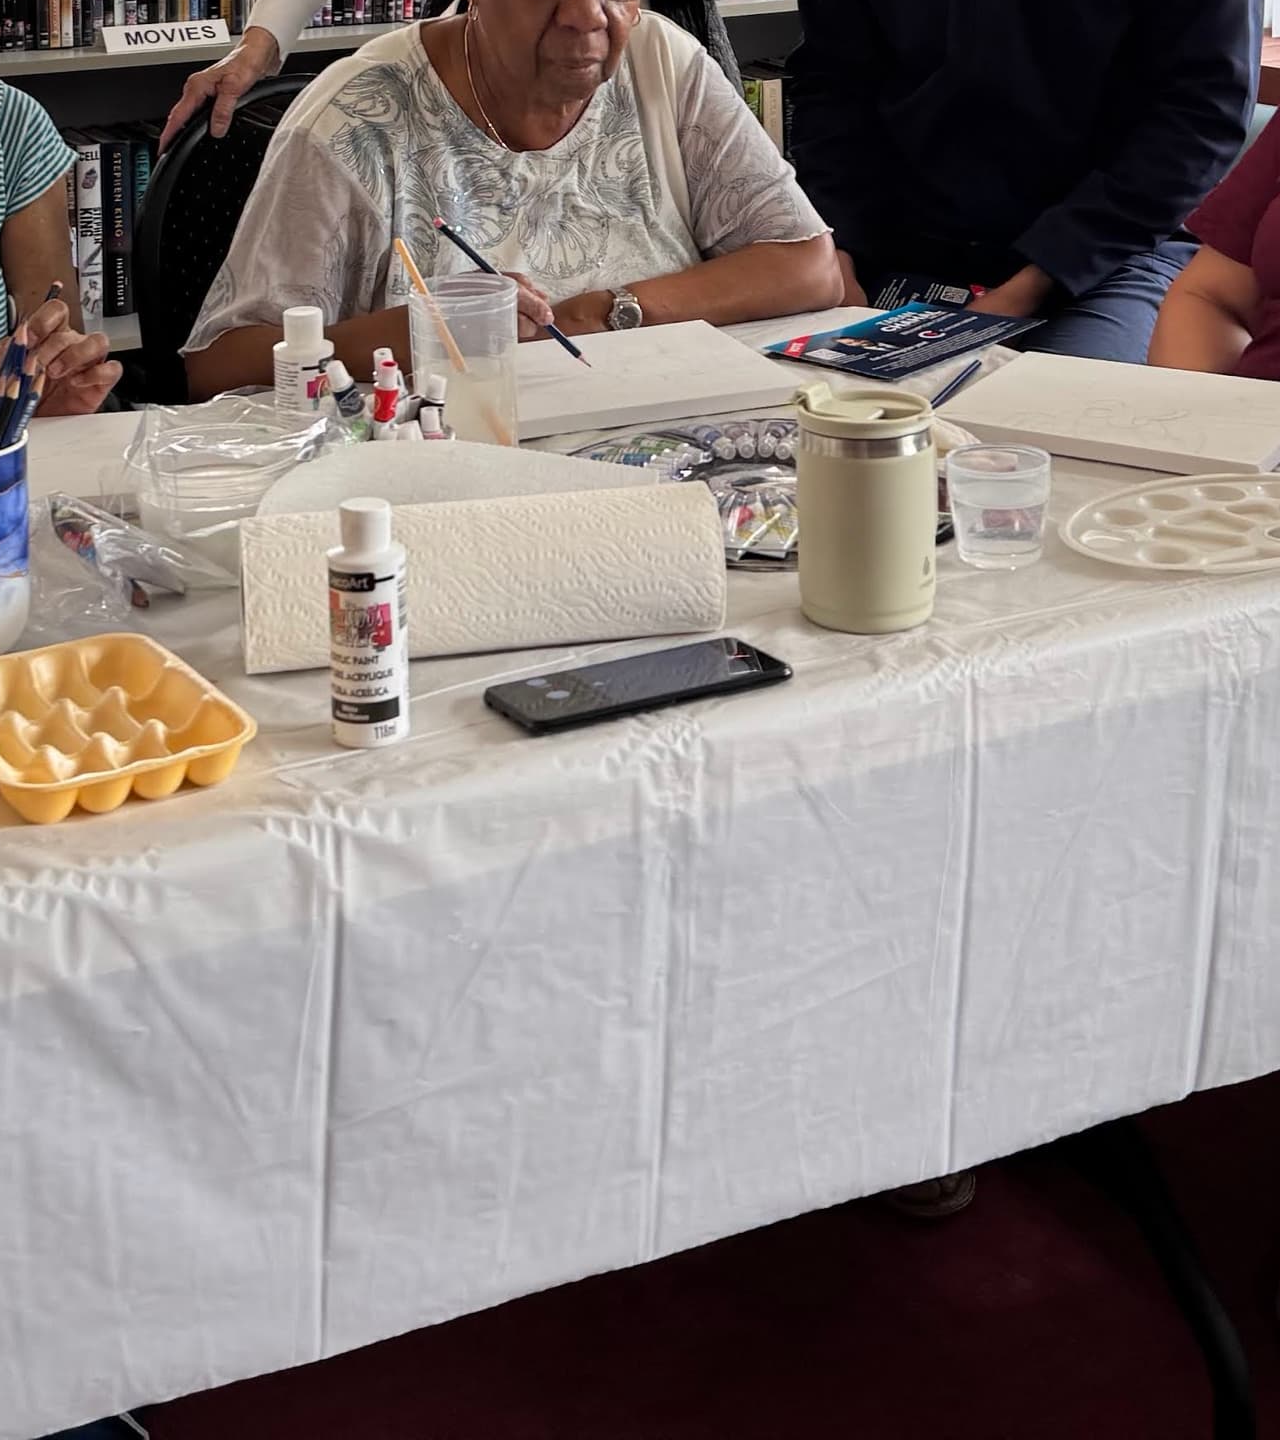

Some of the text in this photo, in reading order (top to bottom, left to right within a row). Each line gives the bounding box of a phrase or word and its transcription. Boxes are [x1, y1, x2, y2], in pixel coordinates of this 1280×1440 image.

[124, 25, 217, 47] MOVIES
[136, 153, 149, 186] DEAN
[112, 152, 125, 238] STEPHEN KING
[79, 207, 93, 238] KING
[114, 257, 125, 308] INSTITUTE
[352, 654, 380, 665] PAINT
[343, 669, 393, 682] ACRYLIQUE
[374, 725, 397, 740] 118ml
